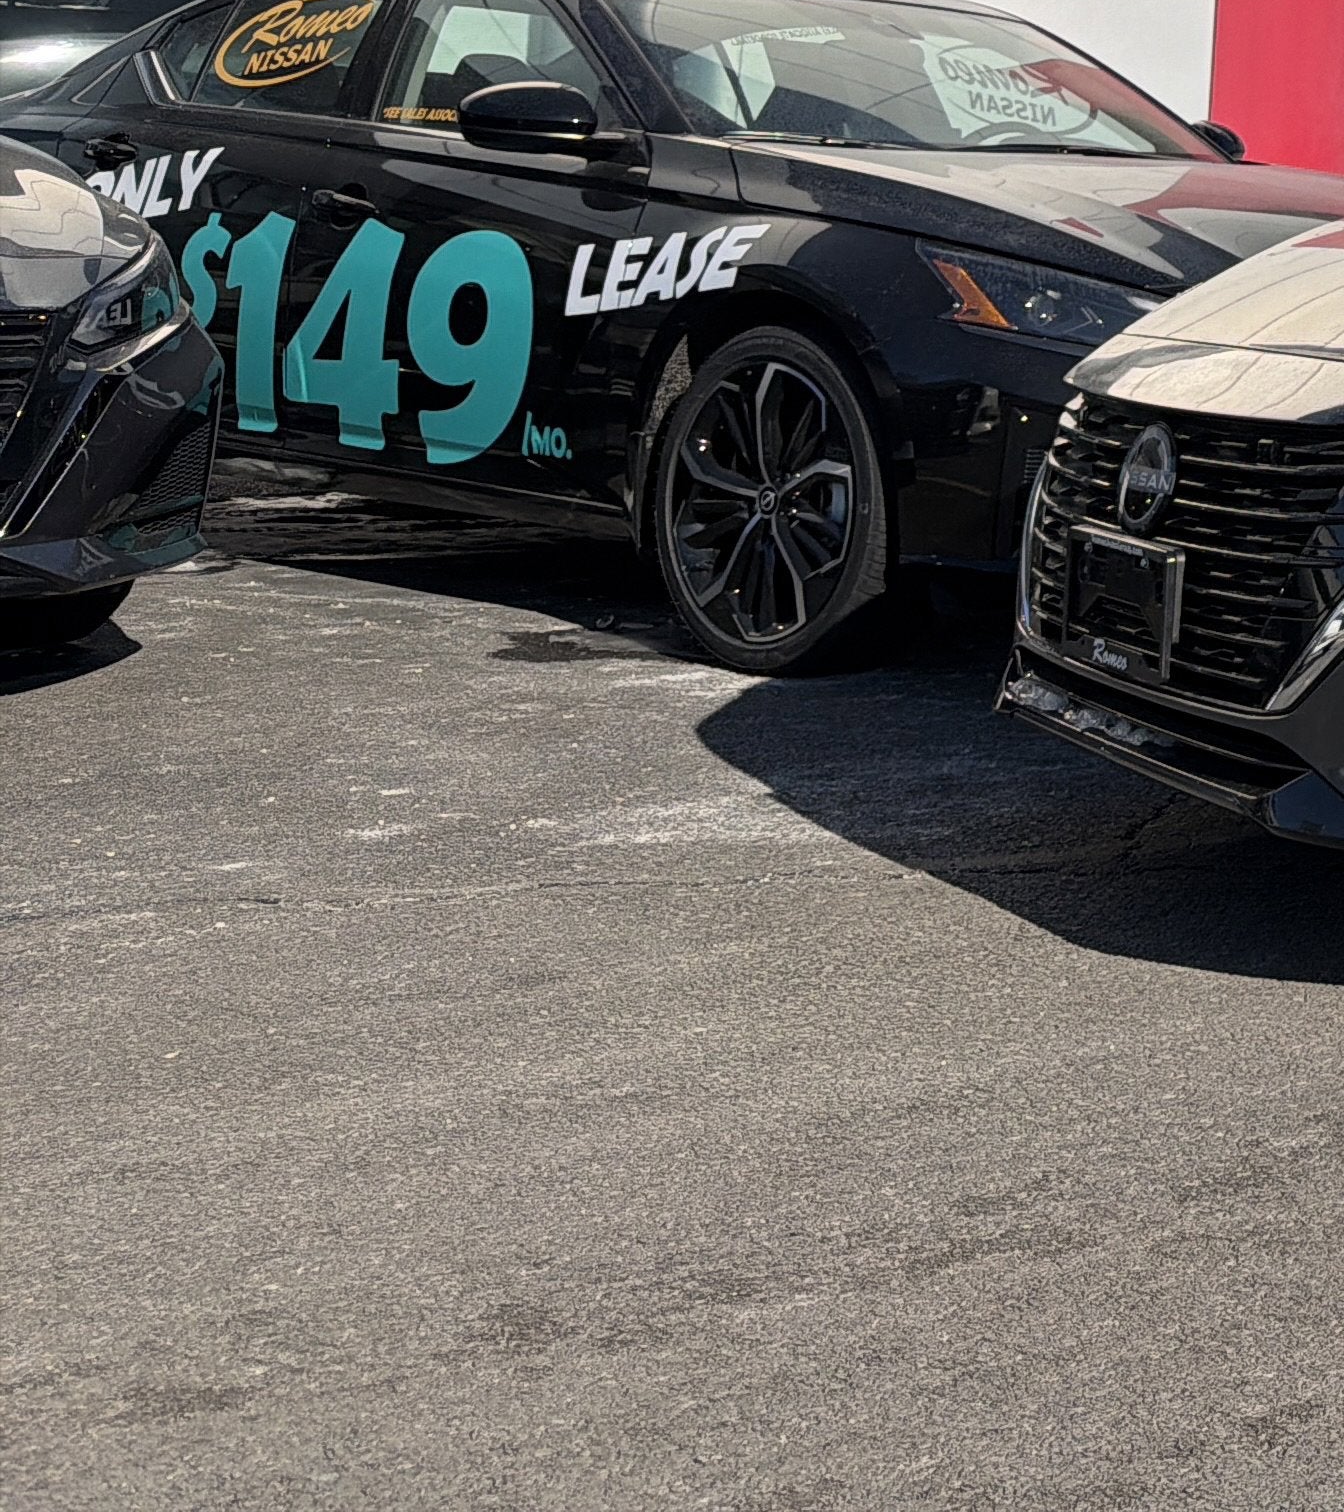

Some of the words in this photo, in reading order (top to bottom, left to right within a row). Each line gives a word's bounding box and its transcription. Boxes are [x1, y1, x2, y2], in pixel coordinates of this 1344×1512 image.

[241, 0, 375, 54] Romeo
[243, 38, 334, 76] NISSAN
[564, 223, 772, 318] LEASE
[181, 210, 533, 466] $149
[521, 410, 573, 460] /MO.
[1129, 471, 1173, 492] SSAN
